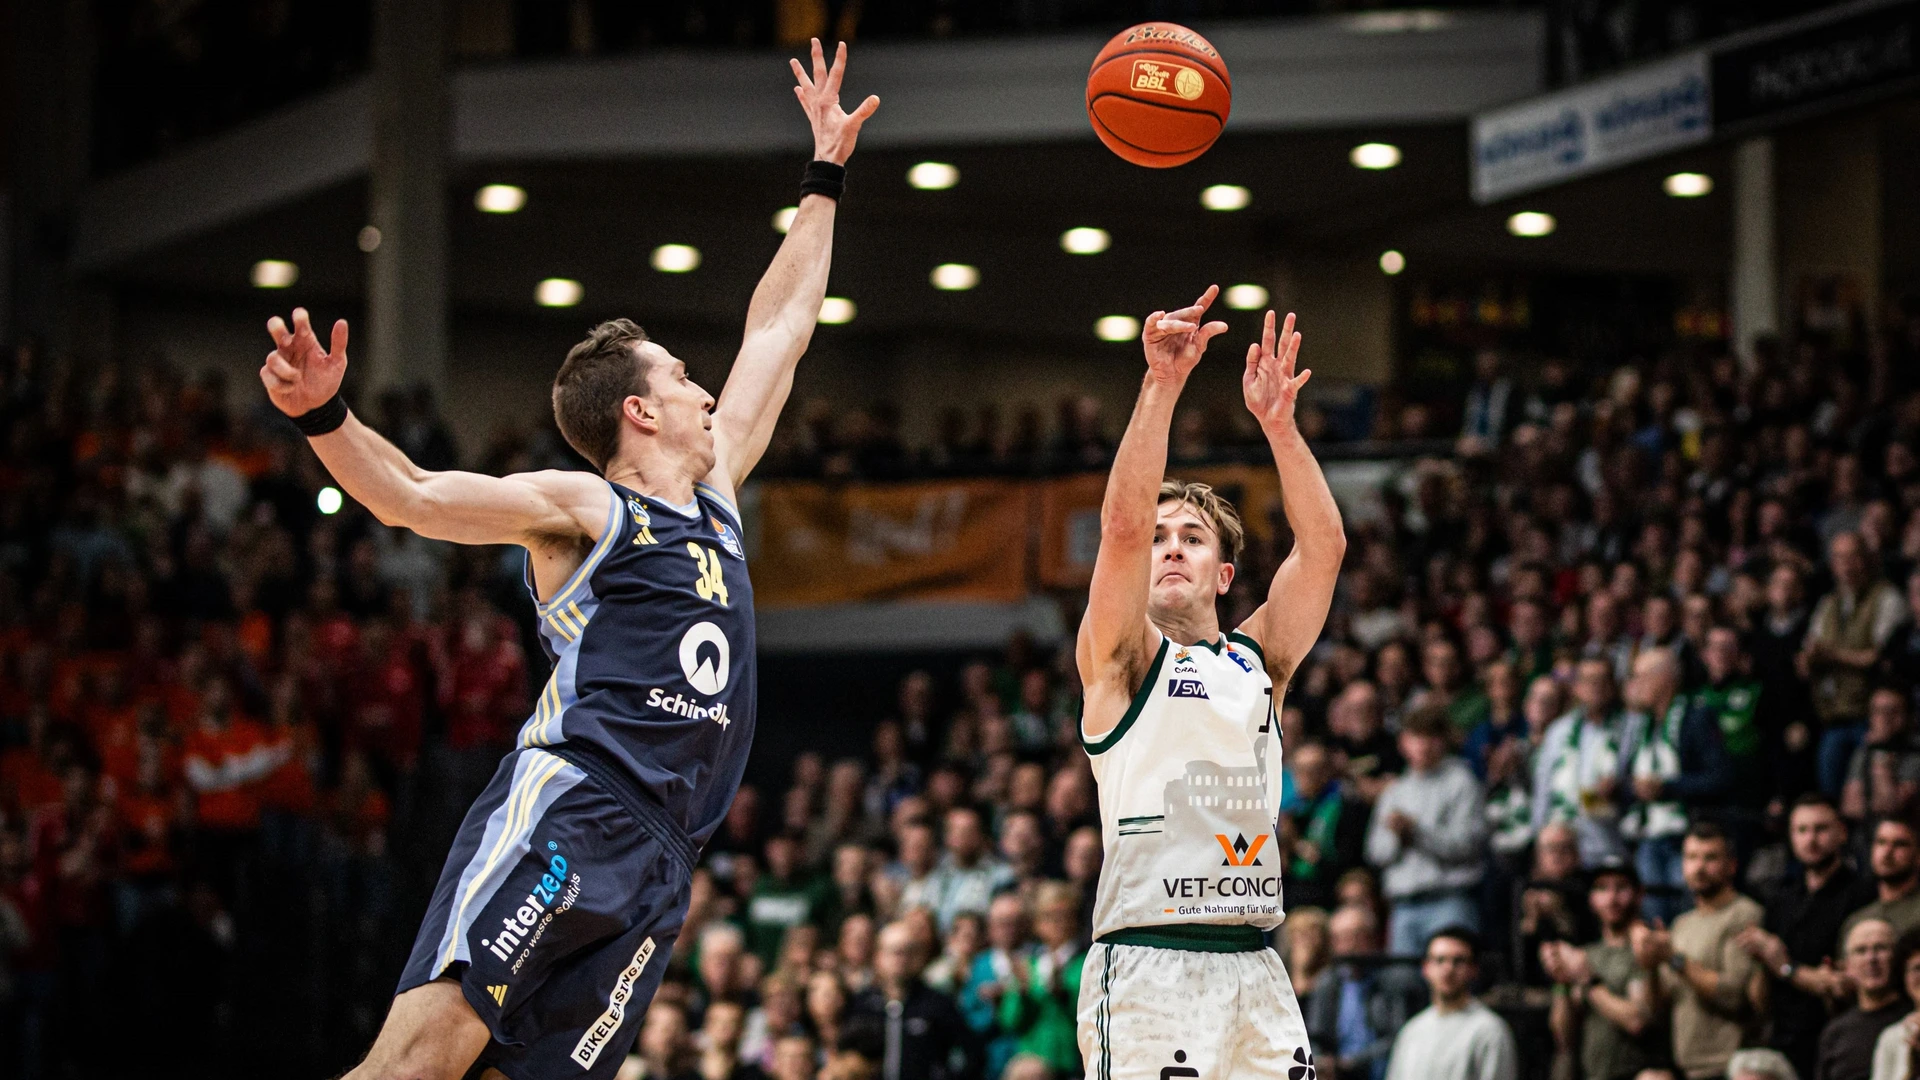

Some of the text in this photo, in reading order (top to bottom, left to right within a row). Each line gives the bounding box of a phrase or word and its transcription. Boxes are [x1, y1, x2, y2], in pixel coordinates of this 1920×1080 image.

[1136, 75, 1167, 91] BBL
[687, 541, 729, 607] 34
[1178, 905, 1202, 915] Gute
[1204, 904, 1246, 915] Nahrung
[1246, 904, 1259, 914] für
[510, 948, 530, 975] zero
[529, 912, 554, 948] waste
[578, 943, 652, 1063] BIKELEASING.DE
